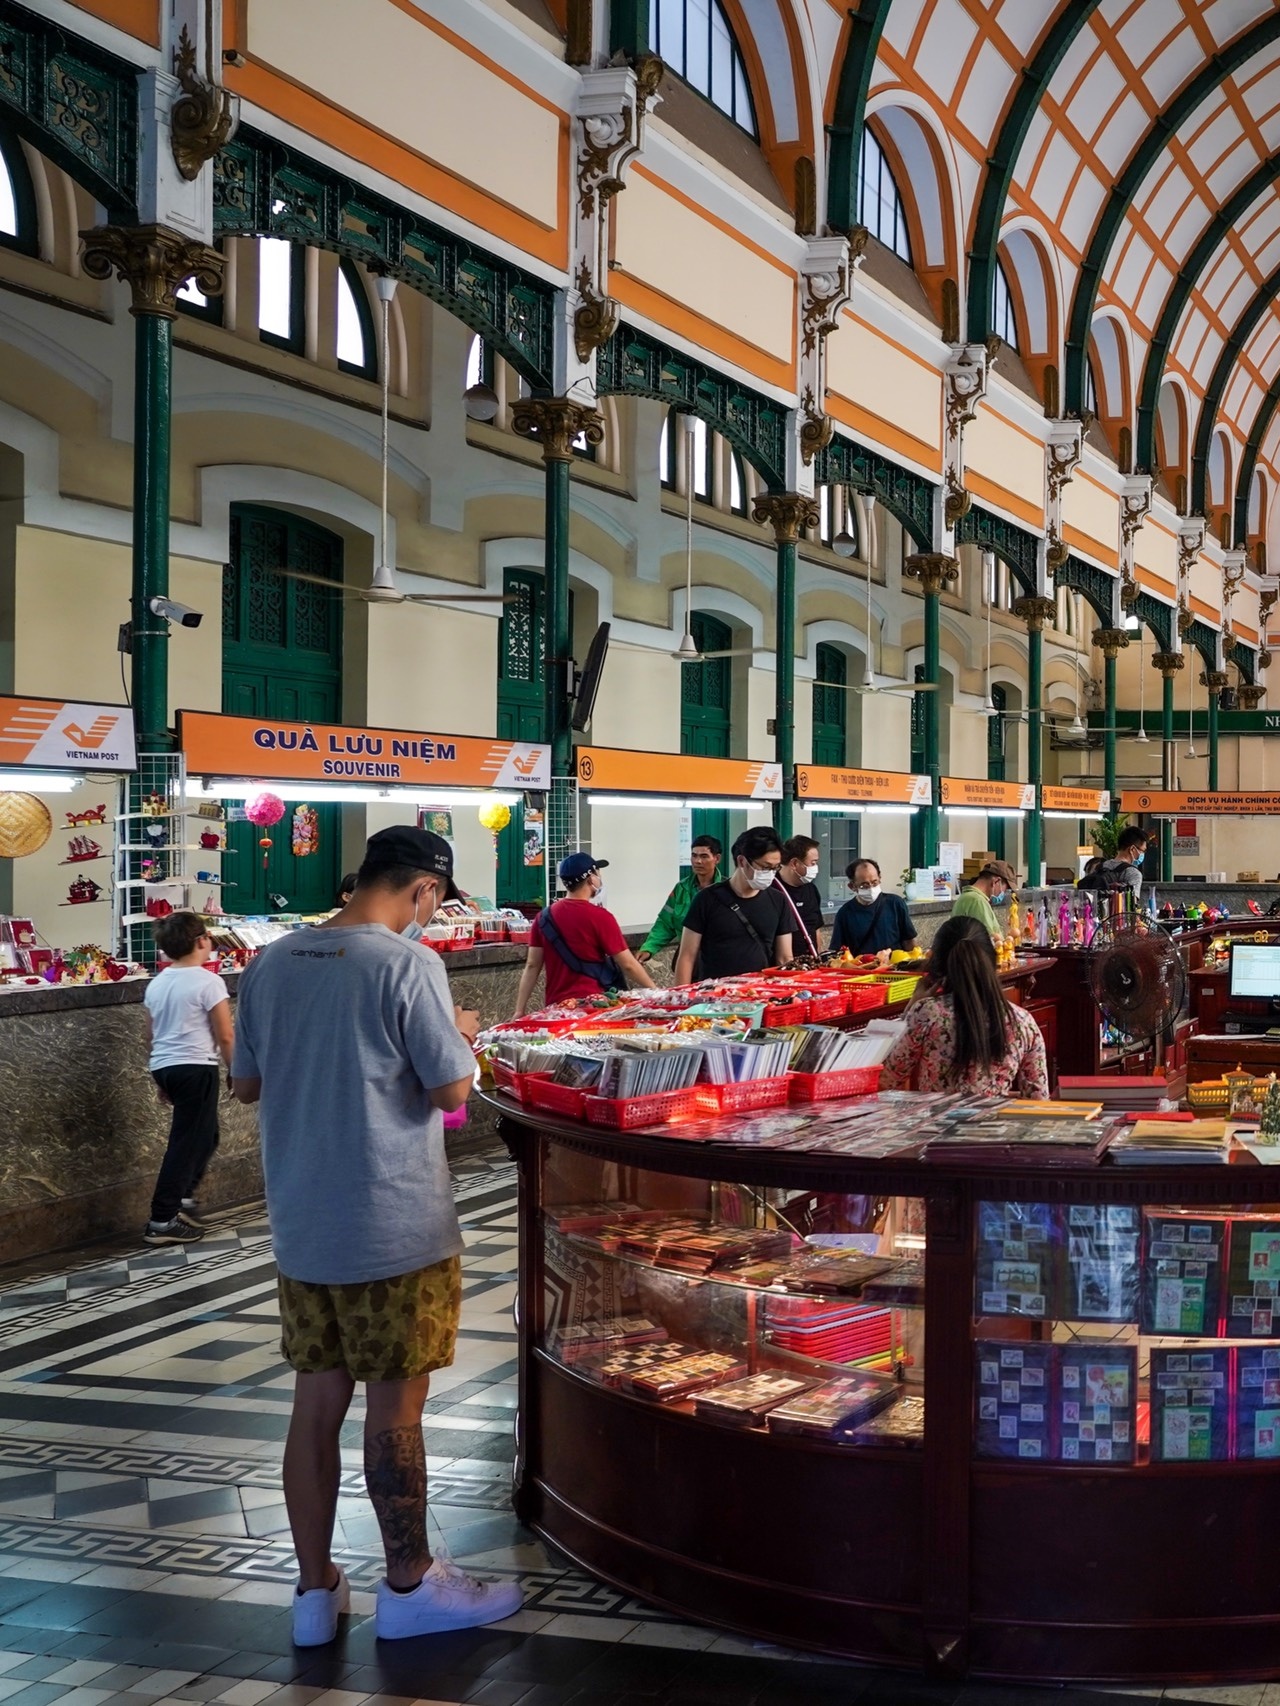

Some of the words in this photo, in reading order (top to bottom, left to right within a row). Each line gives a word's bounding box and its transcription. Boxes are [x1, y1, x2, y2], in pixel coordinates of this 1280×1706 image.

[254, 727, 319, 751] QUÀ
[329, 734, 382, 755] LƯU
[392, 738, 455, 763] NIỆM
[66, 750, 99, 760] VIETNAM
[101, 752, 119, 761] POST
[324, 760, 400, 777] SOUVENIR
[581, 761, 591, 776] 13
[1187, 796, 1206, 806] DỊCH
[1208, 797, 1219, 806] VỤ
[1221, 795, 1243, 804] HÀNH
[1245, 795, 1271, 804] CHÍNH
[291, 949, 337, 958] carhartt
